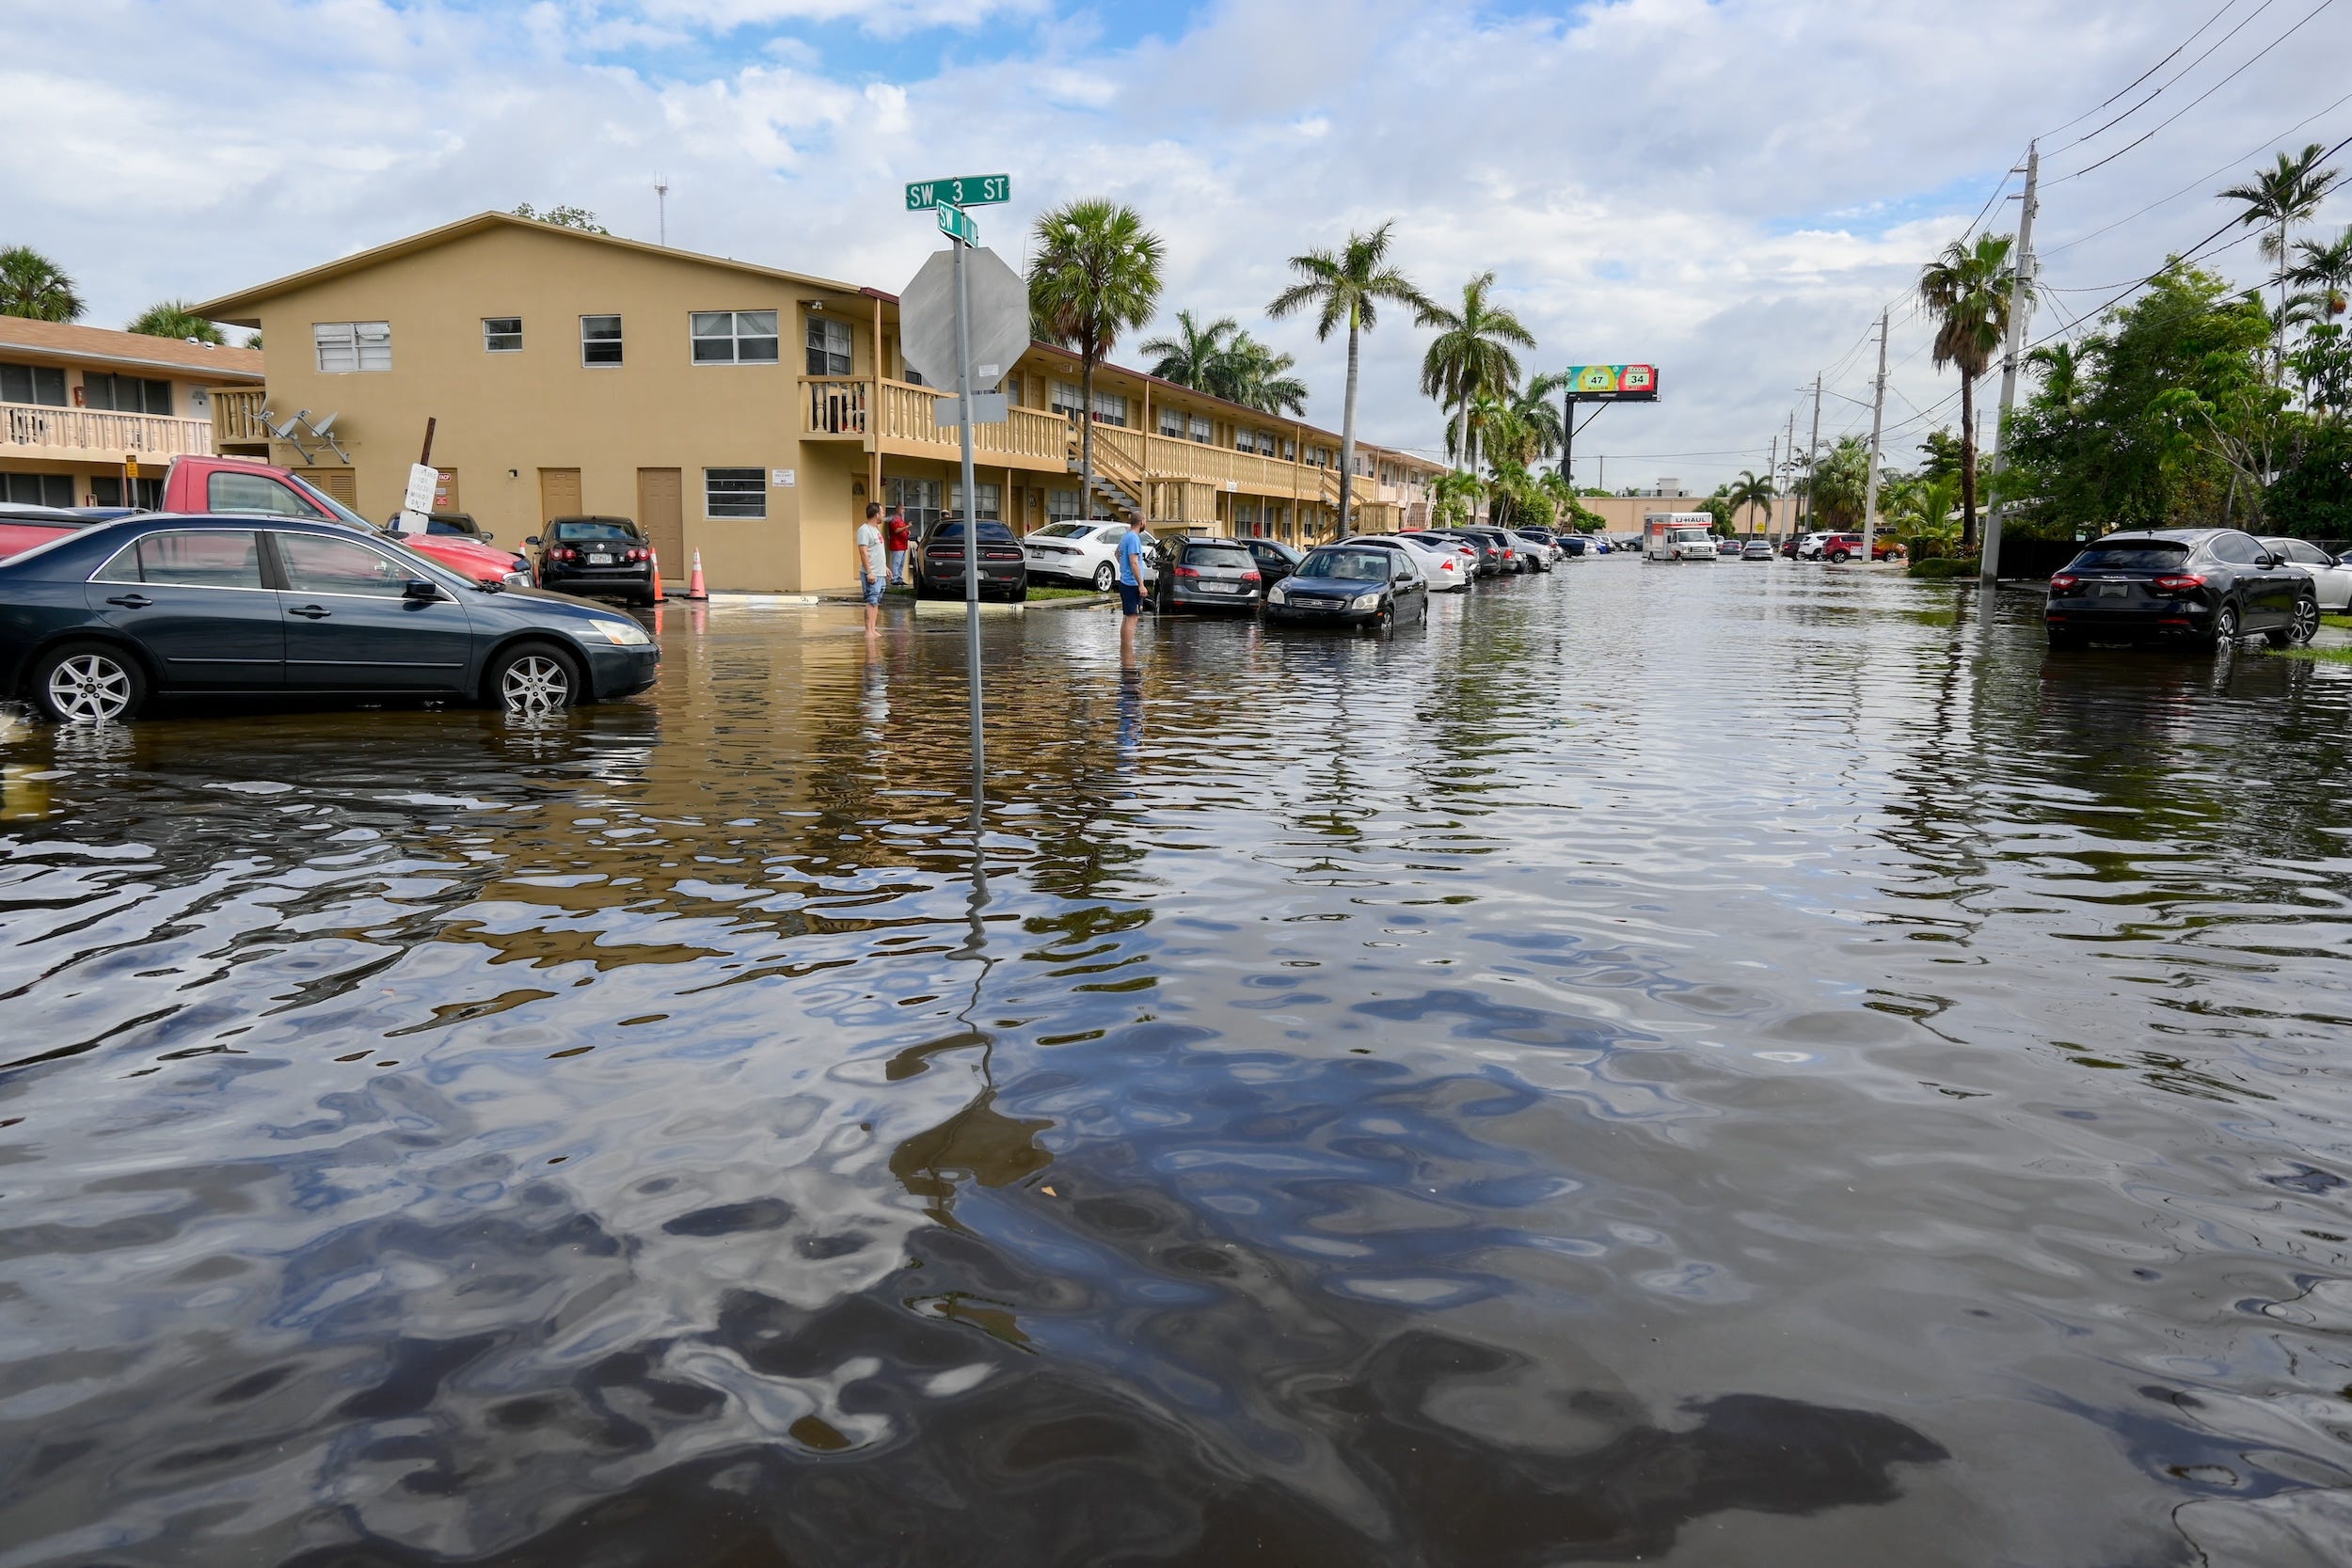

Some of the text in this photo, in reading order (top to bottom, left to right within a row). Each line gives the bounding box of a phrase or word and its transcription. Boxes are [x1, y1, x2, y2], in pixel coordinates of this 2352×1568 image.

[911, 178, 1005, 207] SW 3 ST
[940, 206, 954, 230] SW
[1631, 375, 1644, 384] 34
